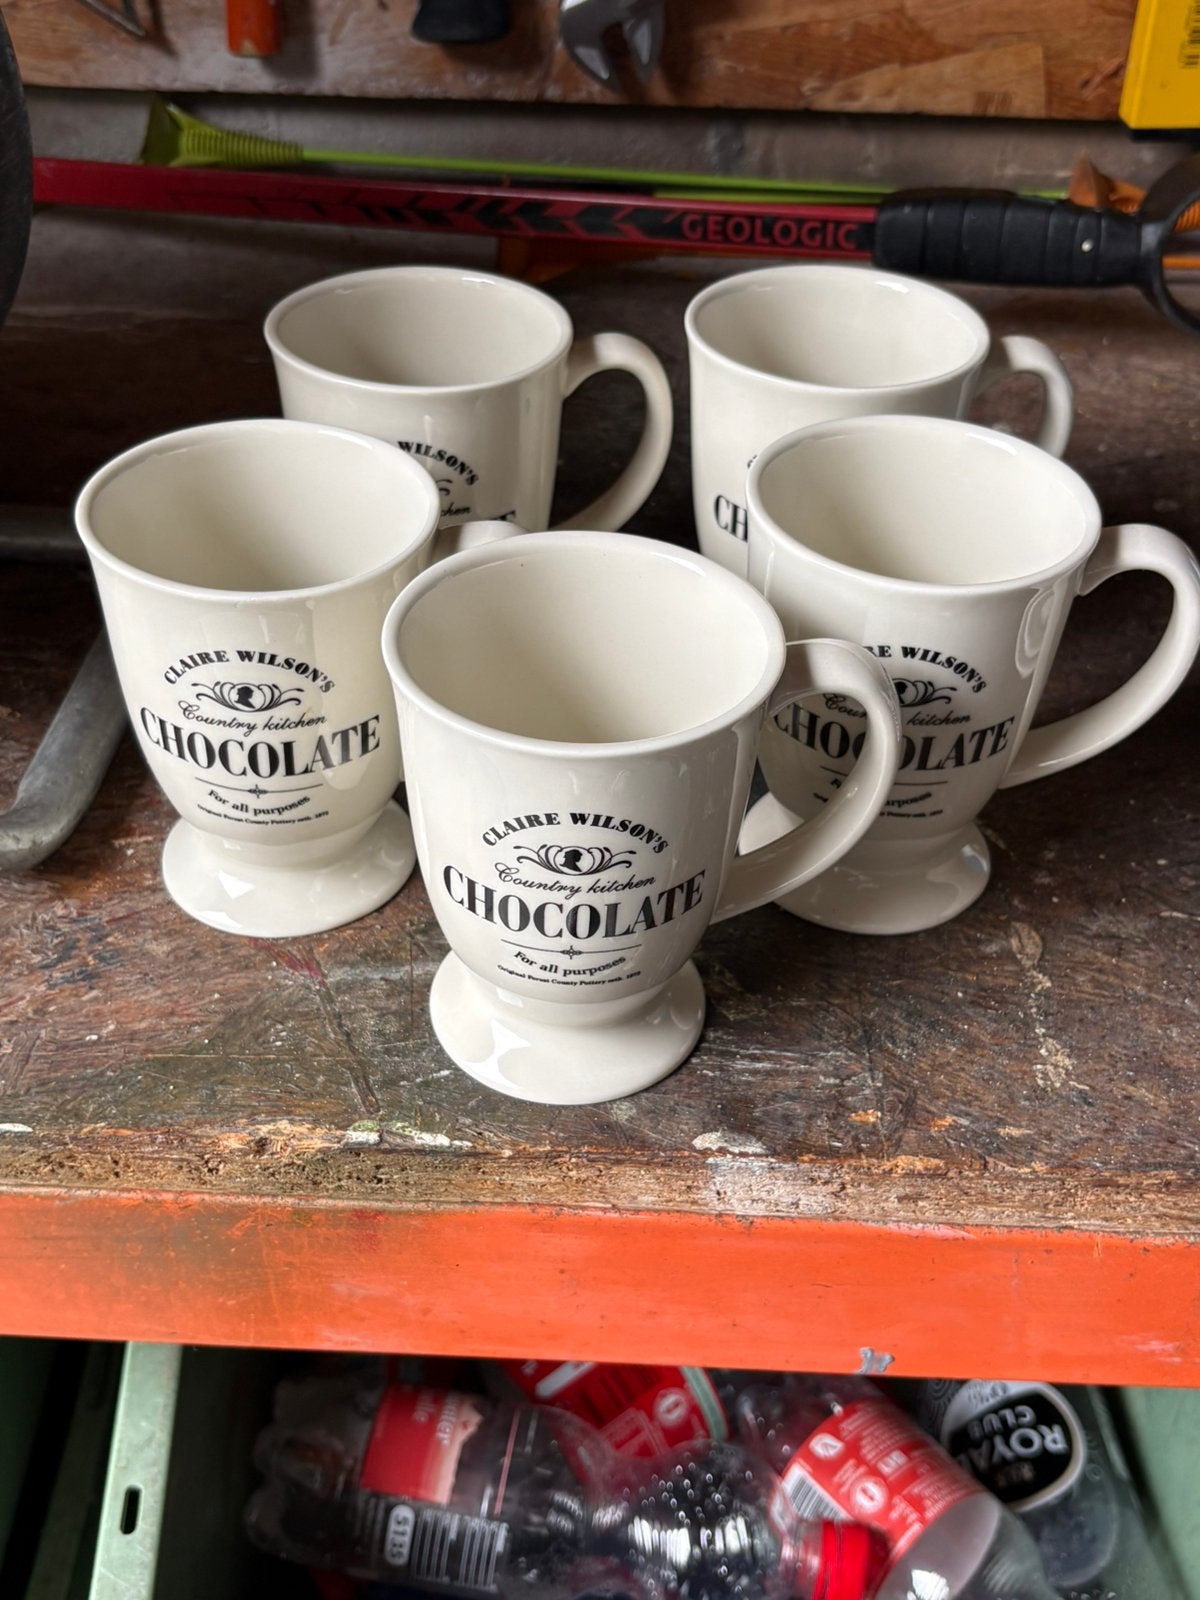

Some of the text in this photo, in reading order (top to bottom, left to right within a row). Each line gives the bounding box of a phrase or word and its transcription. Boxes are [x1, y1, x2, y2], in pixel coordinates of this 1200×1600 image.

[681, 214, 859, 250] GEOLOGIC
[397, 441, 479, 485] WILSON'S
[441, 501, 471, 517] chen
[164, 650, 336, 694] CLAIRE WILSON'S
[901, 646, 987, 694] WILSON'S
[178, 700, 328, 737] Country kitchen
[906, 710, 971, 728] kitchen
[140, 707, 381, 779] CHOCOLATE
[208, 789, 311, 816] For all purposes
[482, 812, 669, 855] CLAIRE WILSON'S
[494, 862, 656, 900] Country kitchen
[443, 865, 706, 940] CHOCOLATE
[514, 951, 626, 977] For all purposes
[967, 1404, 1037, 1440] CLUB
